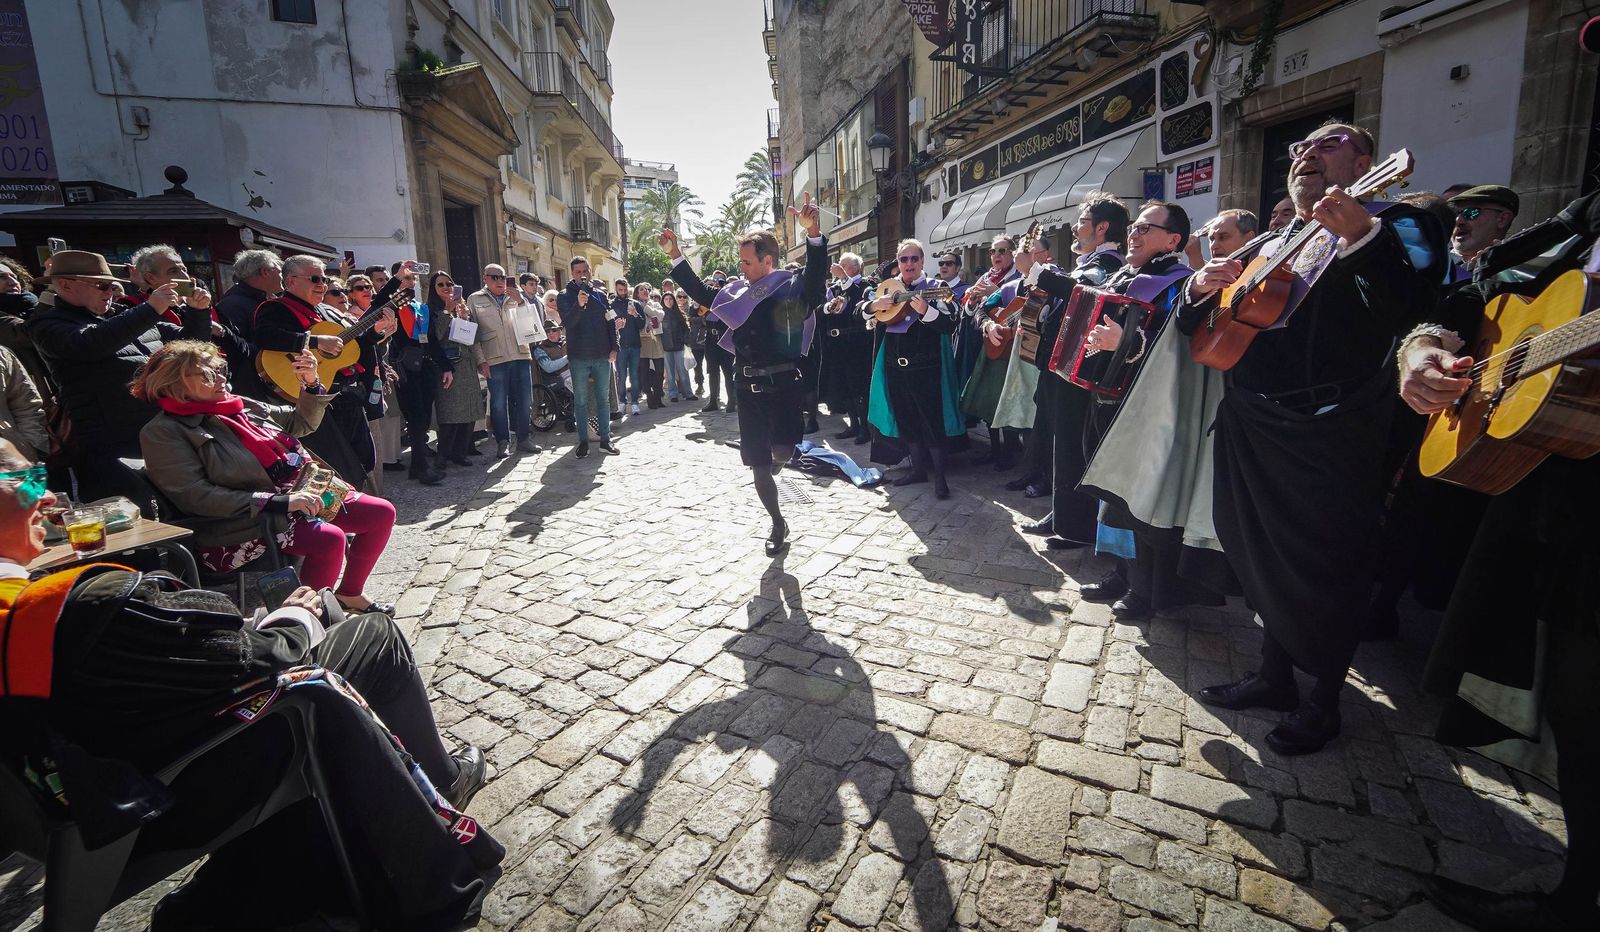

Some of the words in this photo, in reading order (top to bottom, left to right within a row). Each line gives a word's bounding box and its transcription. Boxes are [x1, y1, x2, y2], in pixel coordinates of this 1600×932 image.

[911, 15, 932, 24] AKE
[1283, 60, 1289, 73] 5
[1292, 56, 1299, 70] Y
[1301, 53, 1308, 66] 7
[1000, 146, 1012, 167] LA
[1012, 134, 1041, 163] ROSA
[1055, 116, 1080, 144] ORO
[2, 146, 48, 172] 026
